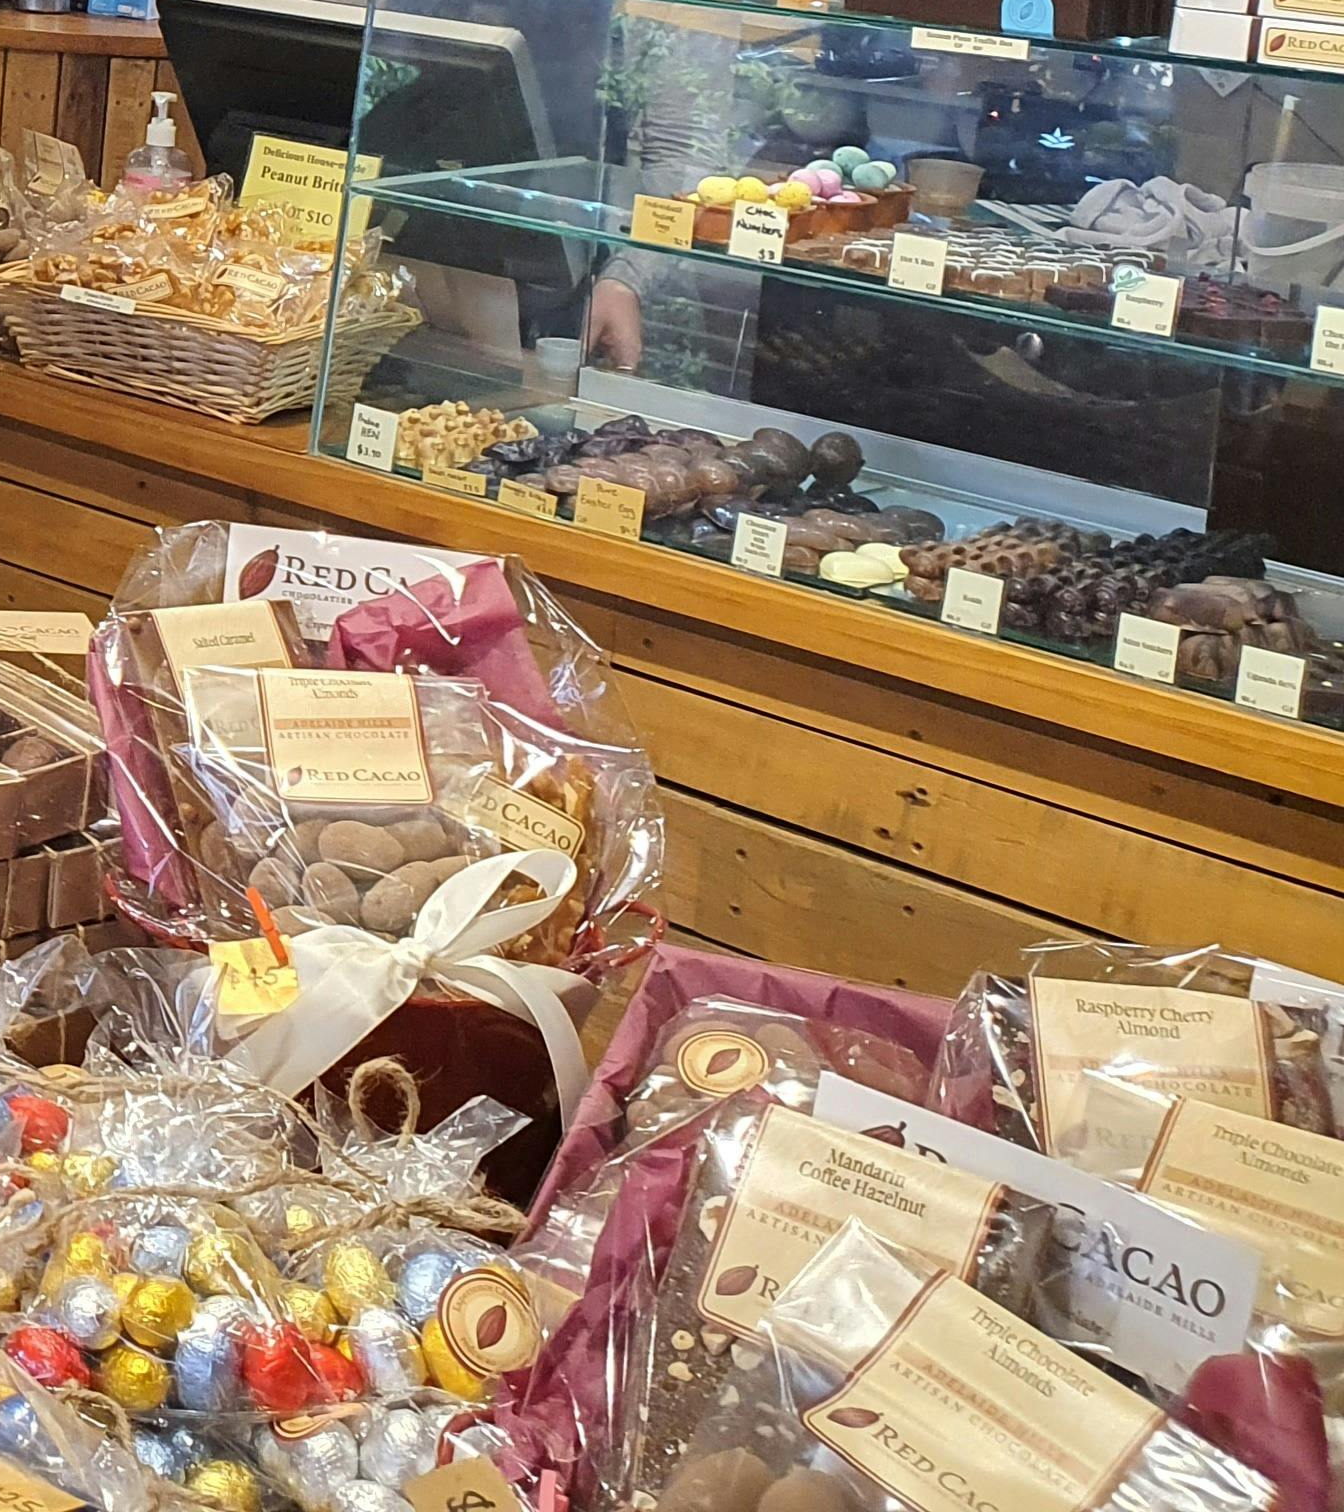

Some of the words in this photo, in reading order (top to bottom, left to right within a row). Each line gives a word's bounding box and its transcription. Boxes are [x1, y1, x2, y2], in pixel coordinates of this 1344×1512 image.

[1287, 36, 1318, 50] RED
[263, 146, 305, 163] Delicious
[261, 165, 309, 188] Peanut
[228, 268, 248, 280] RED
[247, 271, 278, 290] CACAO
[1125, 294, 1165, 309] Raspberry
[283, 556, 357, 591] RED
[19, 624, 80, 636] CACAO
[192, 635, 218, 649] Salted
[219, 632, 256, 646] Caramel
[279, 731, 330, 740] ARTISAN
[335, 730, 410, 740] CHOCOLATE
[307, 768, 350, 782] RED
[353, 768, 422, 782] CACAO
[500, 802, 572, 851] CACAO
[1075, 998, 1158, 1024] Raspberry
[1160, 1007, 1214, 1024] Cherry
[1115, 1020, 1181, 1039] Almond
[1212, 1124, 1261, 1150] Triple
[1261, 1138, 1344, 1178] Chocolate
[1238, 1150, 1311, 1185] Almonds
[825, 1148, 908, 1190] Mandarin
[799, 1160, 852, 1191] Coffee
[852, 1179, 927, 1219] Hazelnut
[1162, 1183, 1243, 1216] ARTISAN
[1054, 1201, 1227, 1318] CACAO
[969, 1306, 1019, 1347] Triple
[1016, 1339, 1096, 1398] Chocolate
[889, 1360, 964, 1414] ARTISAN
[984, 1343, 1058, 1400] Almonds
[871, 1423, 938, 1474] RED
[968, 1413, 1076, 1497] CHOCOLATE
